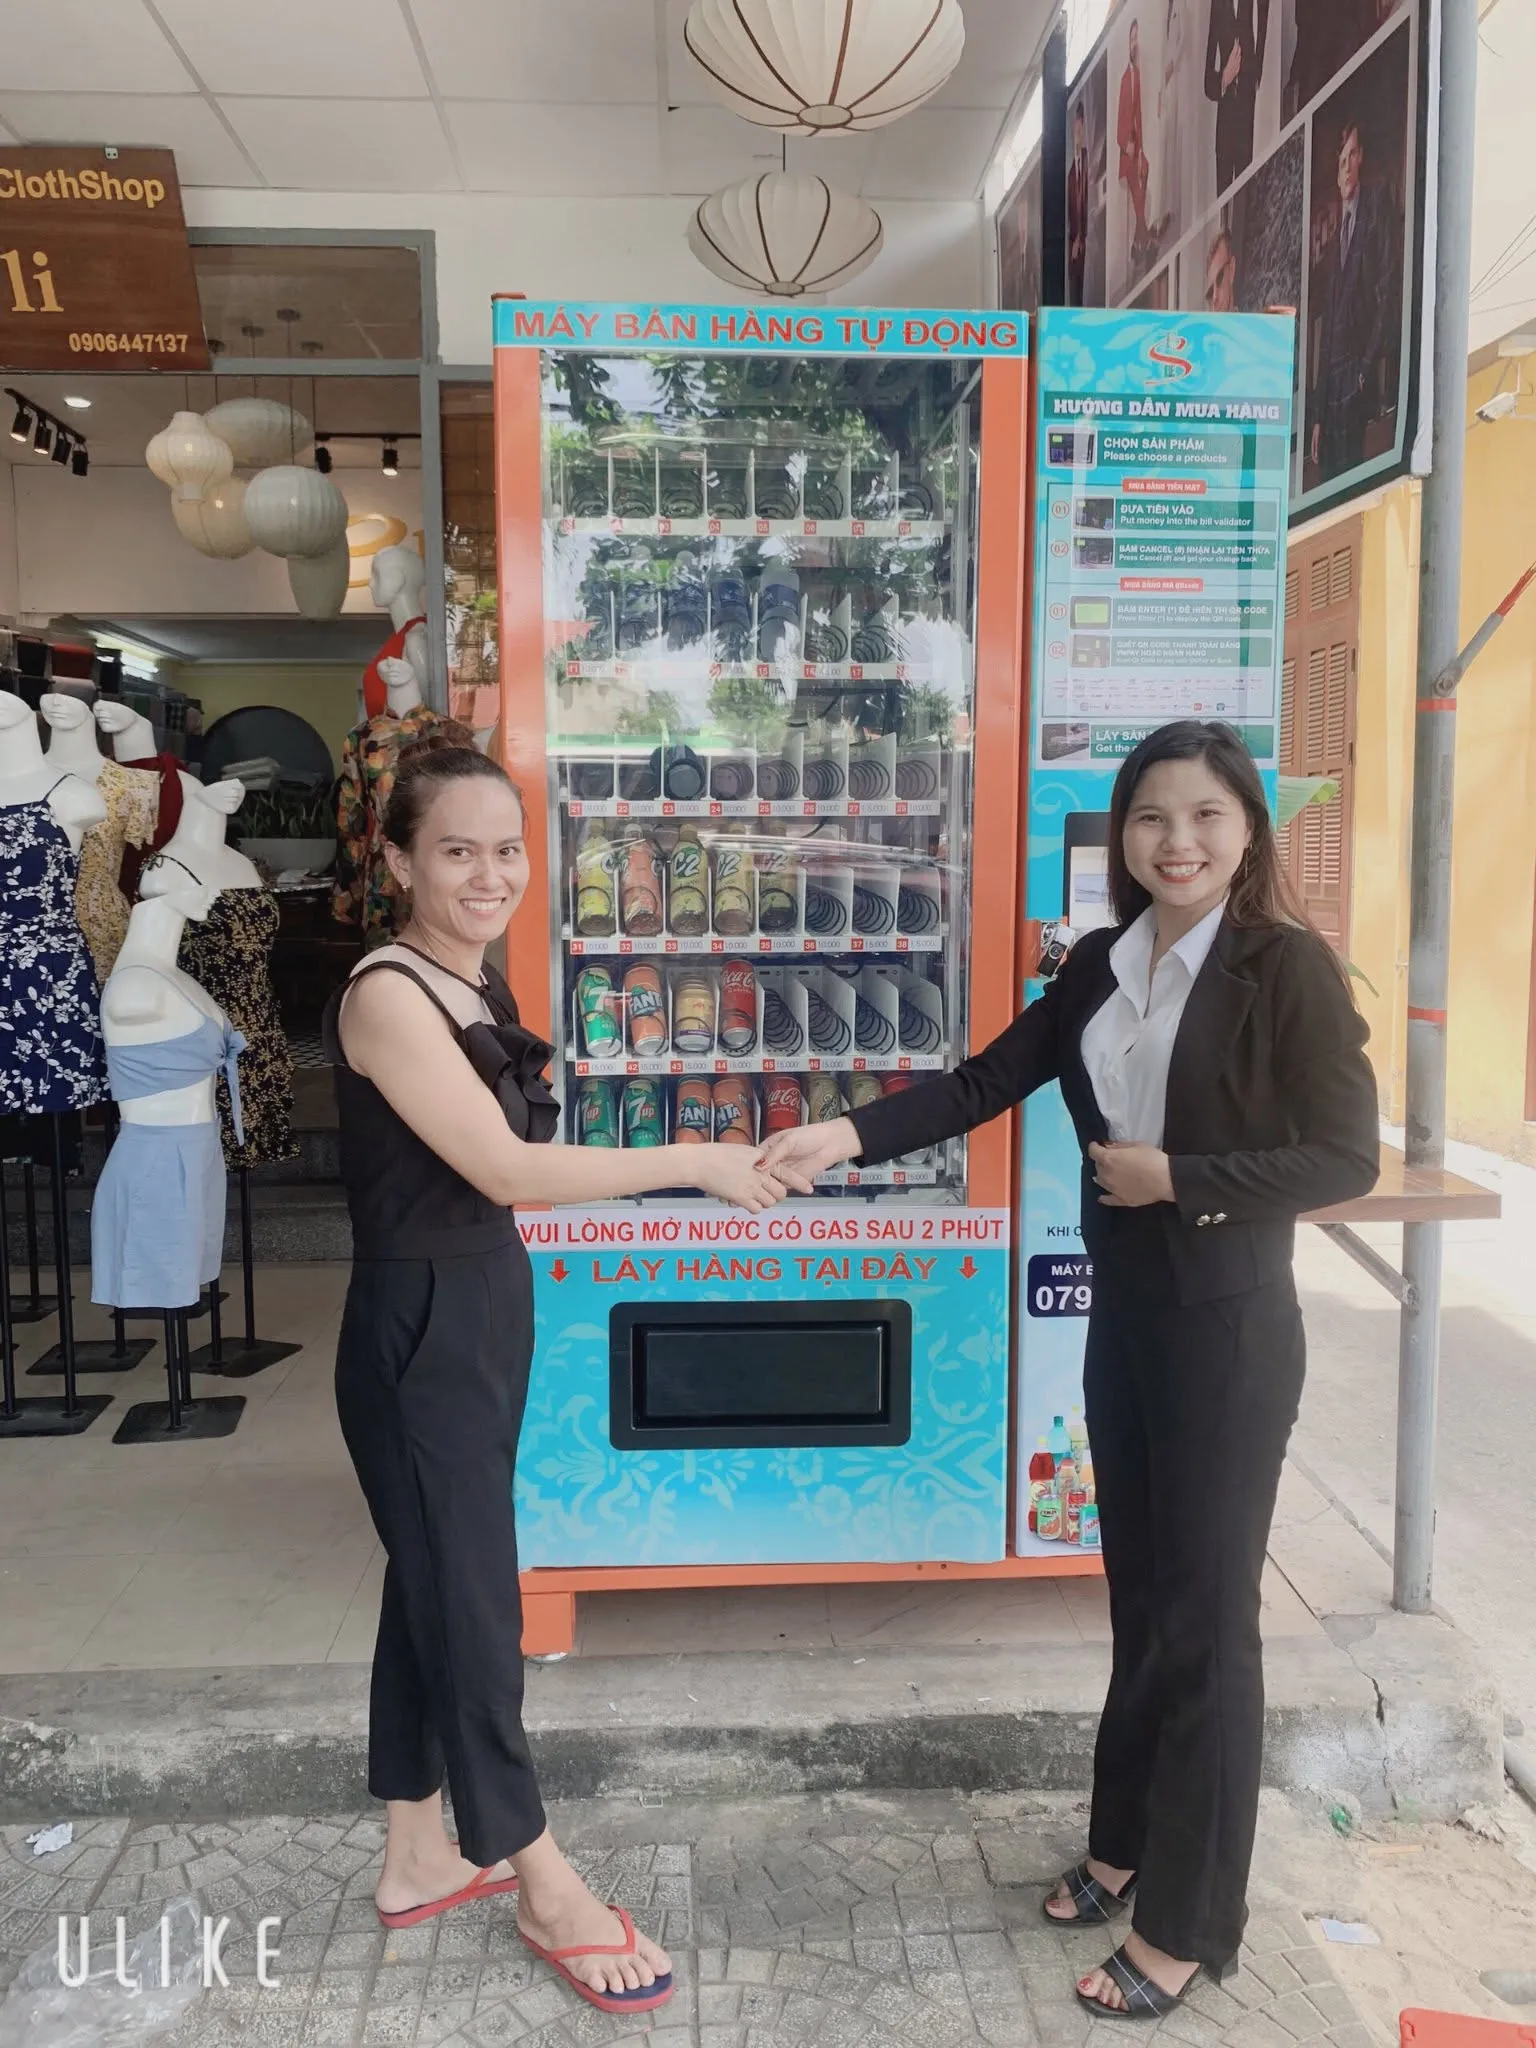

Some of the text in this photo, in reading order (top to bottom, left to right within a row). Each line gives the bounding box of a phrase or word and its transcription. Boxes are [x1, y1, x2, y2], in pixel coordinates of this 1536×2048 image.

[514, 305, 1017, 352] MÁY BÁN HÀNG TỰ ĐỘNG
[69, 333, 188, 353] 0906447137
[1175, 402, 1220, 418] MUA
[1103, 437, 1138, 451] CHỌN
[1103, 451, 1227, 464] Please choose a products
[1120, 516, 1135, 524] Put
[1137, 517, 1165, 526] money
[1167, 516, 1184, 525] into
[1185, 516, 1198, 525] the
[1214, 518, 1251, 526] validator
[1140, 545, 1172, 553] CANCEL
[1244, 606, 1268, 614] CODE
[1095, 743, 1113, 753] Get
[1115, 743, 1130, 753] the
[519, 1214, 1004, 1244] VUI LÒNG MỞ NƯỚC CÓ GAS SAU 2 PHÚT
[1046, 1226, 1070, 1237] KHI
[676, 1252, 783, 1281] HÀNG
[793, 1256, 850, 1286] TẠI
[860, 1251, 937, 1280] ĐÂY
[1051, 1262, 1082, 1276] MÁY
[1036, 1285, 1092, 1311] 079
